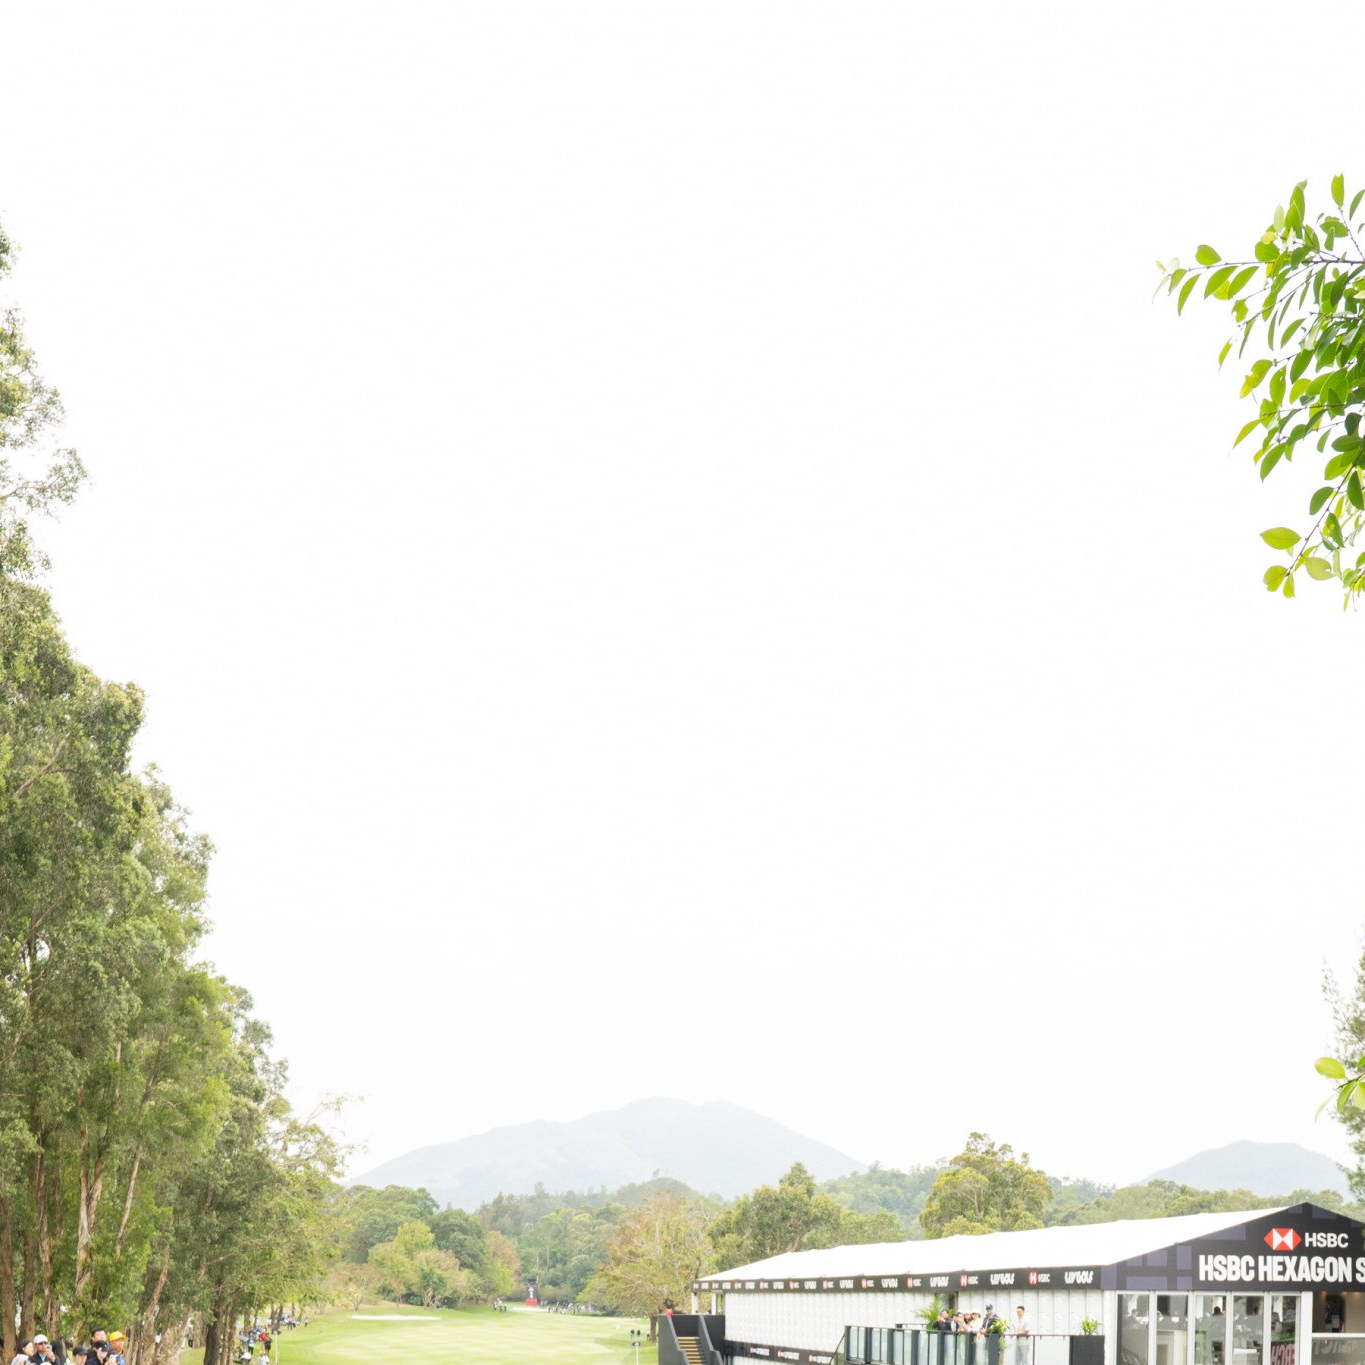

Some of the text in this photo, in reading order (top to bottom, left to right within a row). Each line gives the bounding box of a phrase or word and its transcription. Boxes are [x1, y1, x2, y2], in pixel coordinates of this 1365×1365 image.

[1305, 1232, 1349, 1248] HSBC
[1199, 1254, 1255, 1281] HSBC
[1258, 1255, 1353, 1282] HEXAGON
